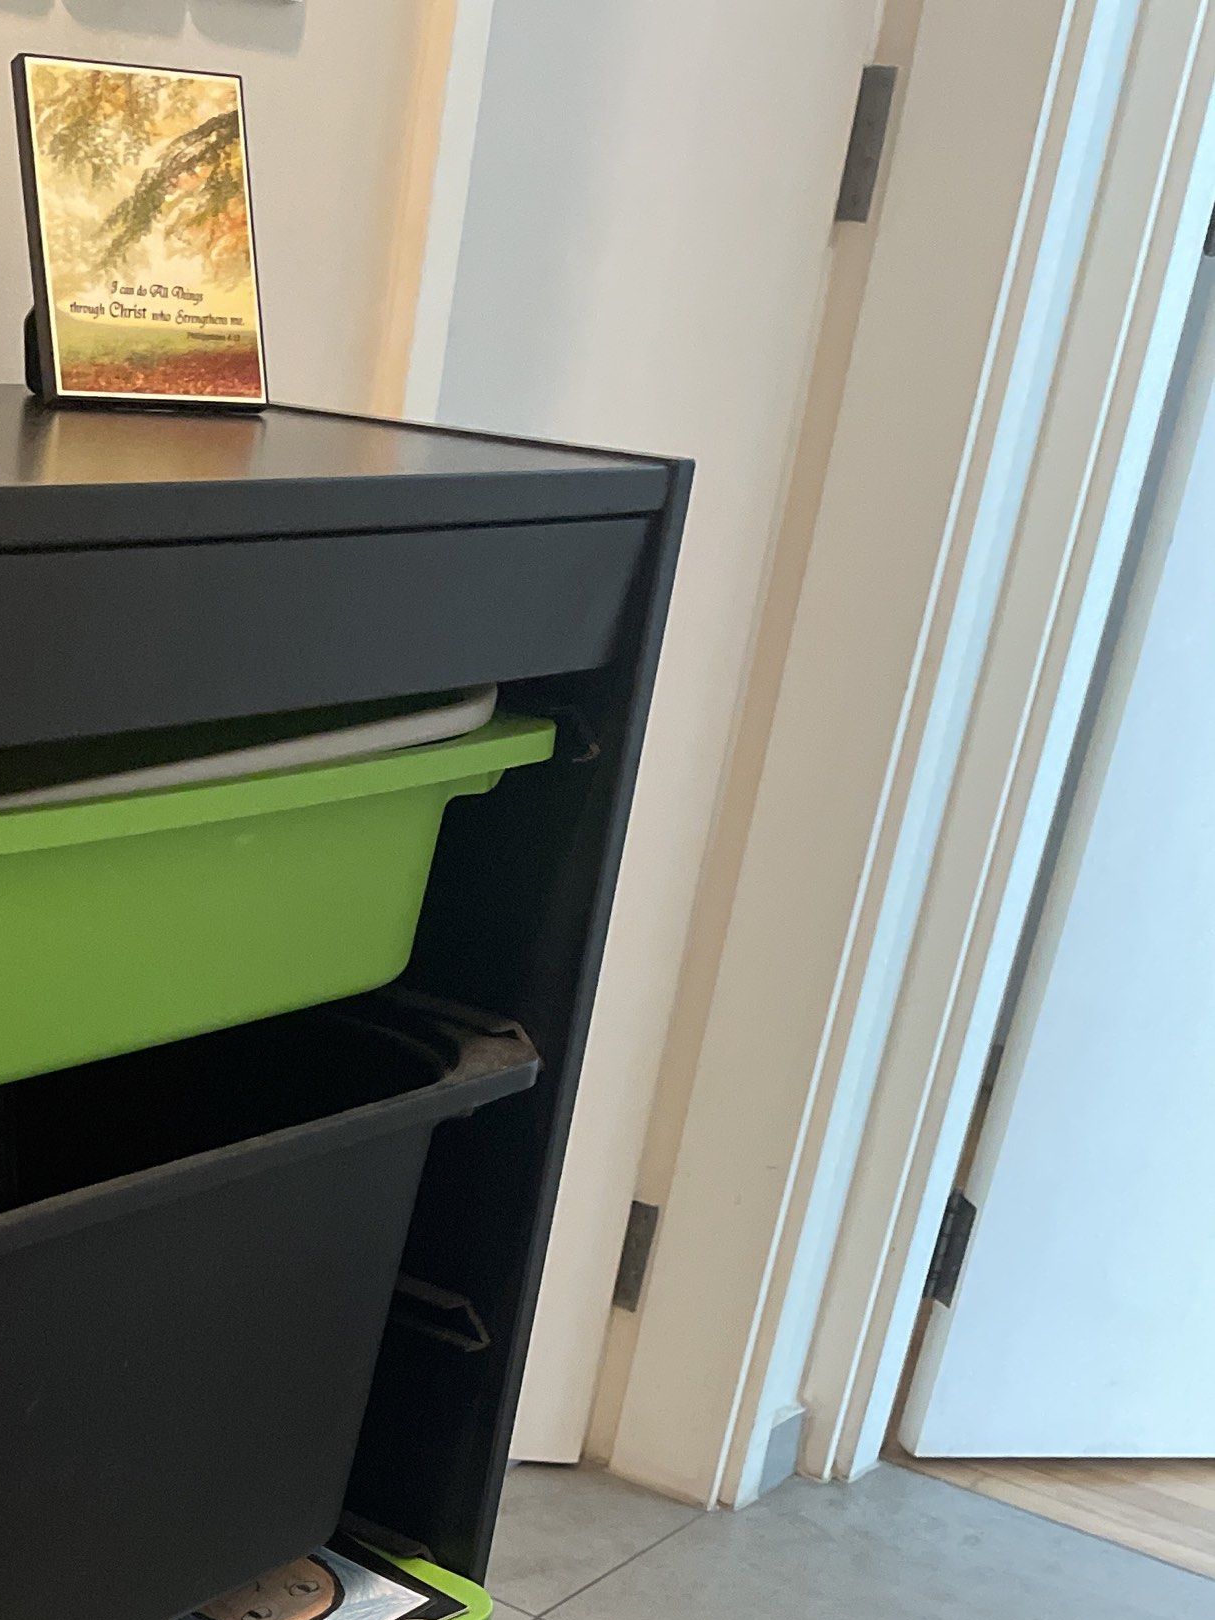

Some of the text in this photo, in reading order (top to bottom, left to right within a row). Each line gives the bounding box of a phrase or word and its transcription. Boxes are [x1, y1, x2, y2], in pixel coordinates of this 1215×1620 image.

[119, 287, 135, 295] can
[137, 285, 148, 297] do
[149, 284, 169, 299] All
[171, 285, 204, 306] Things
[70, 301, 105, 319] through
[109, 301, 147, 319] Christ
[151, 310, 172, 322] who
[175, 309, 228, 328] Strengthens
